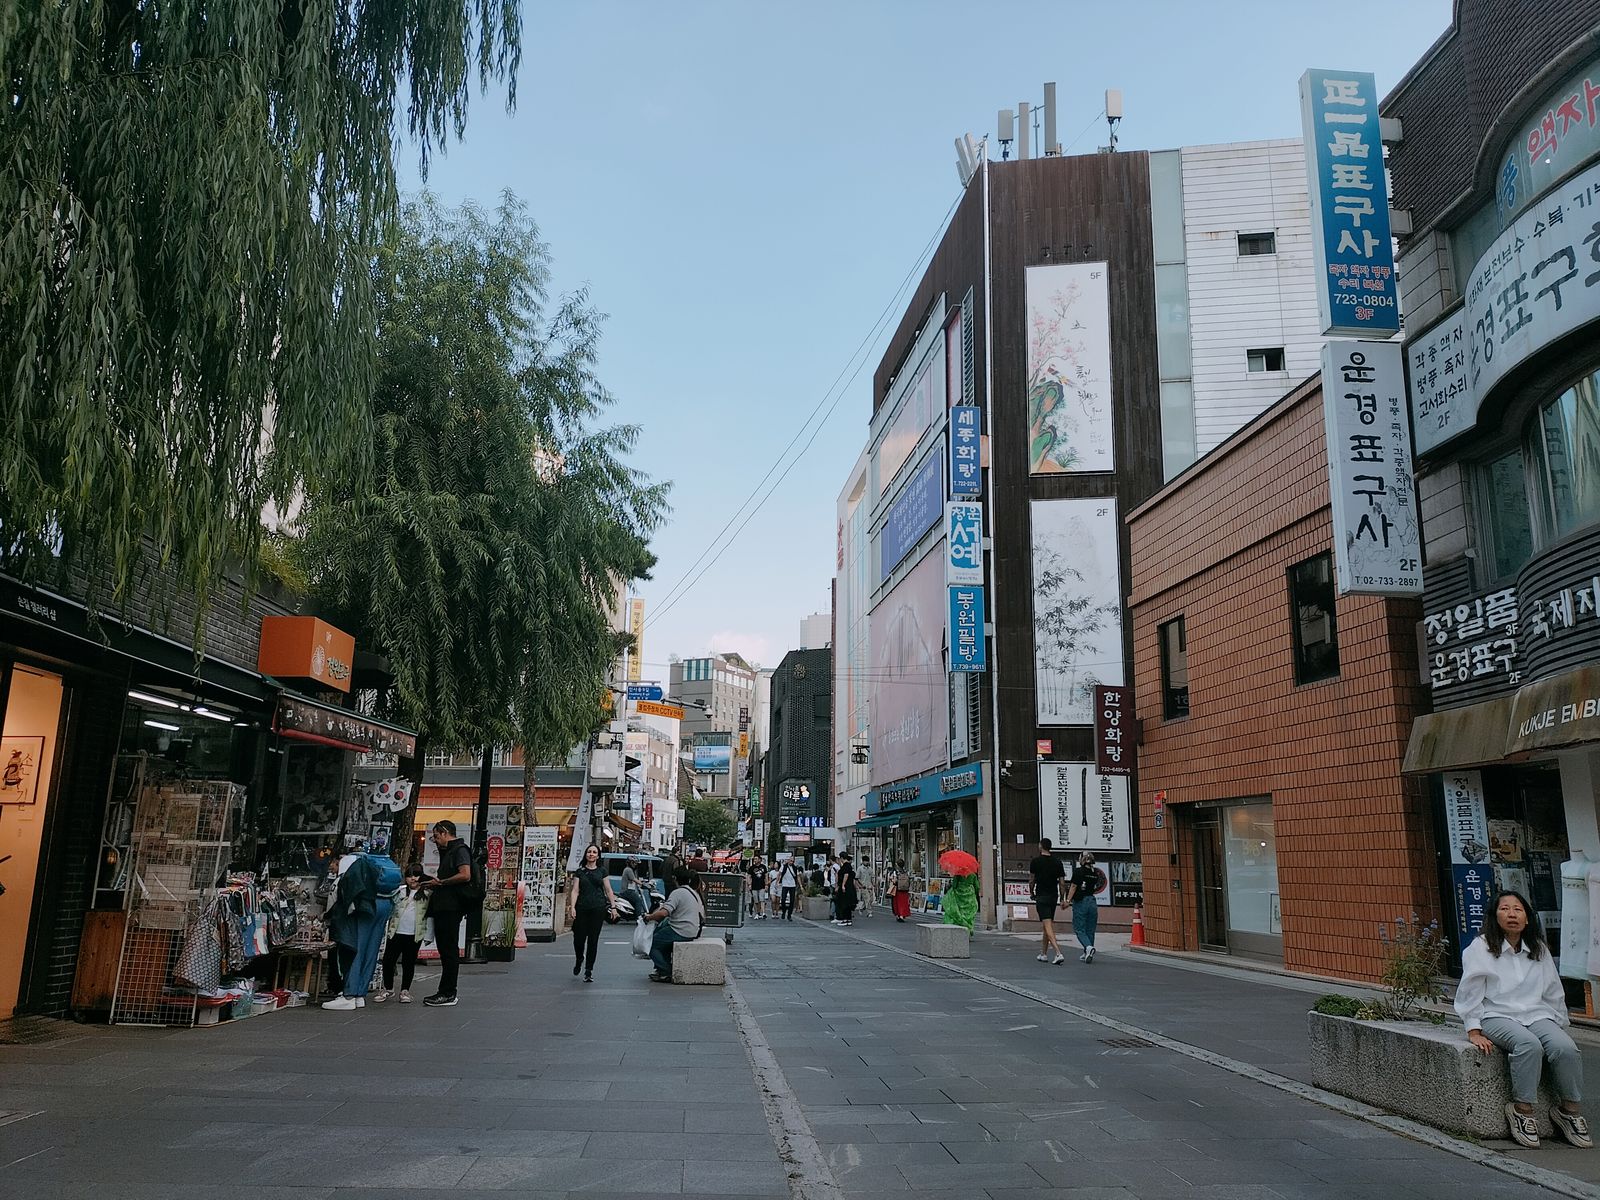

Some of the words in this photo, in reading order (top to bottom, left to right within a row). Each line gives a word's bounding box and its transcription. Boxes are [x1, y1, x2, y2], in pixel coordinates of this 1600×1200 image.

[1333, 293, 1394, 307] 723-0804
[1355, 306, 1374, 320] 3F
[1438, 411, 1451, 430] 2F
[956, 410, 977, 478] 세종화랑
[1341, 351, 1394, 548] 운경표구사
[1096, 508, 1108, 516] 2F
[1399, 558, 1418, 571] 2F
[1424, 587, 1519, 645] 정일품
[1505, 623, 1519, 636] 3F
[1431, 638, 1518, 689] 운경표구
[1508, 671, 1522, 685] 2F
[1103, 692, 1124, 762] 한양화랑
[1518, 708, 1557, 738] KUKJE
[798, 816, 824, 827] CAKE
